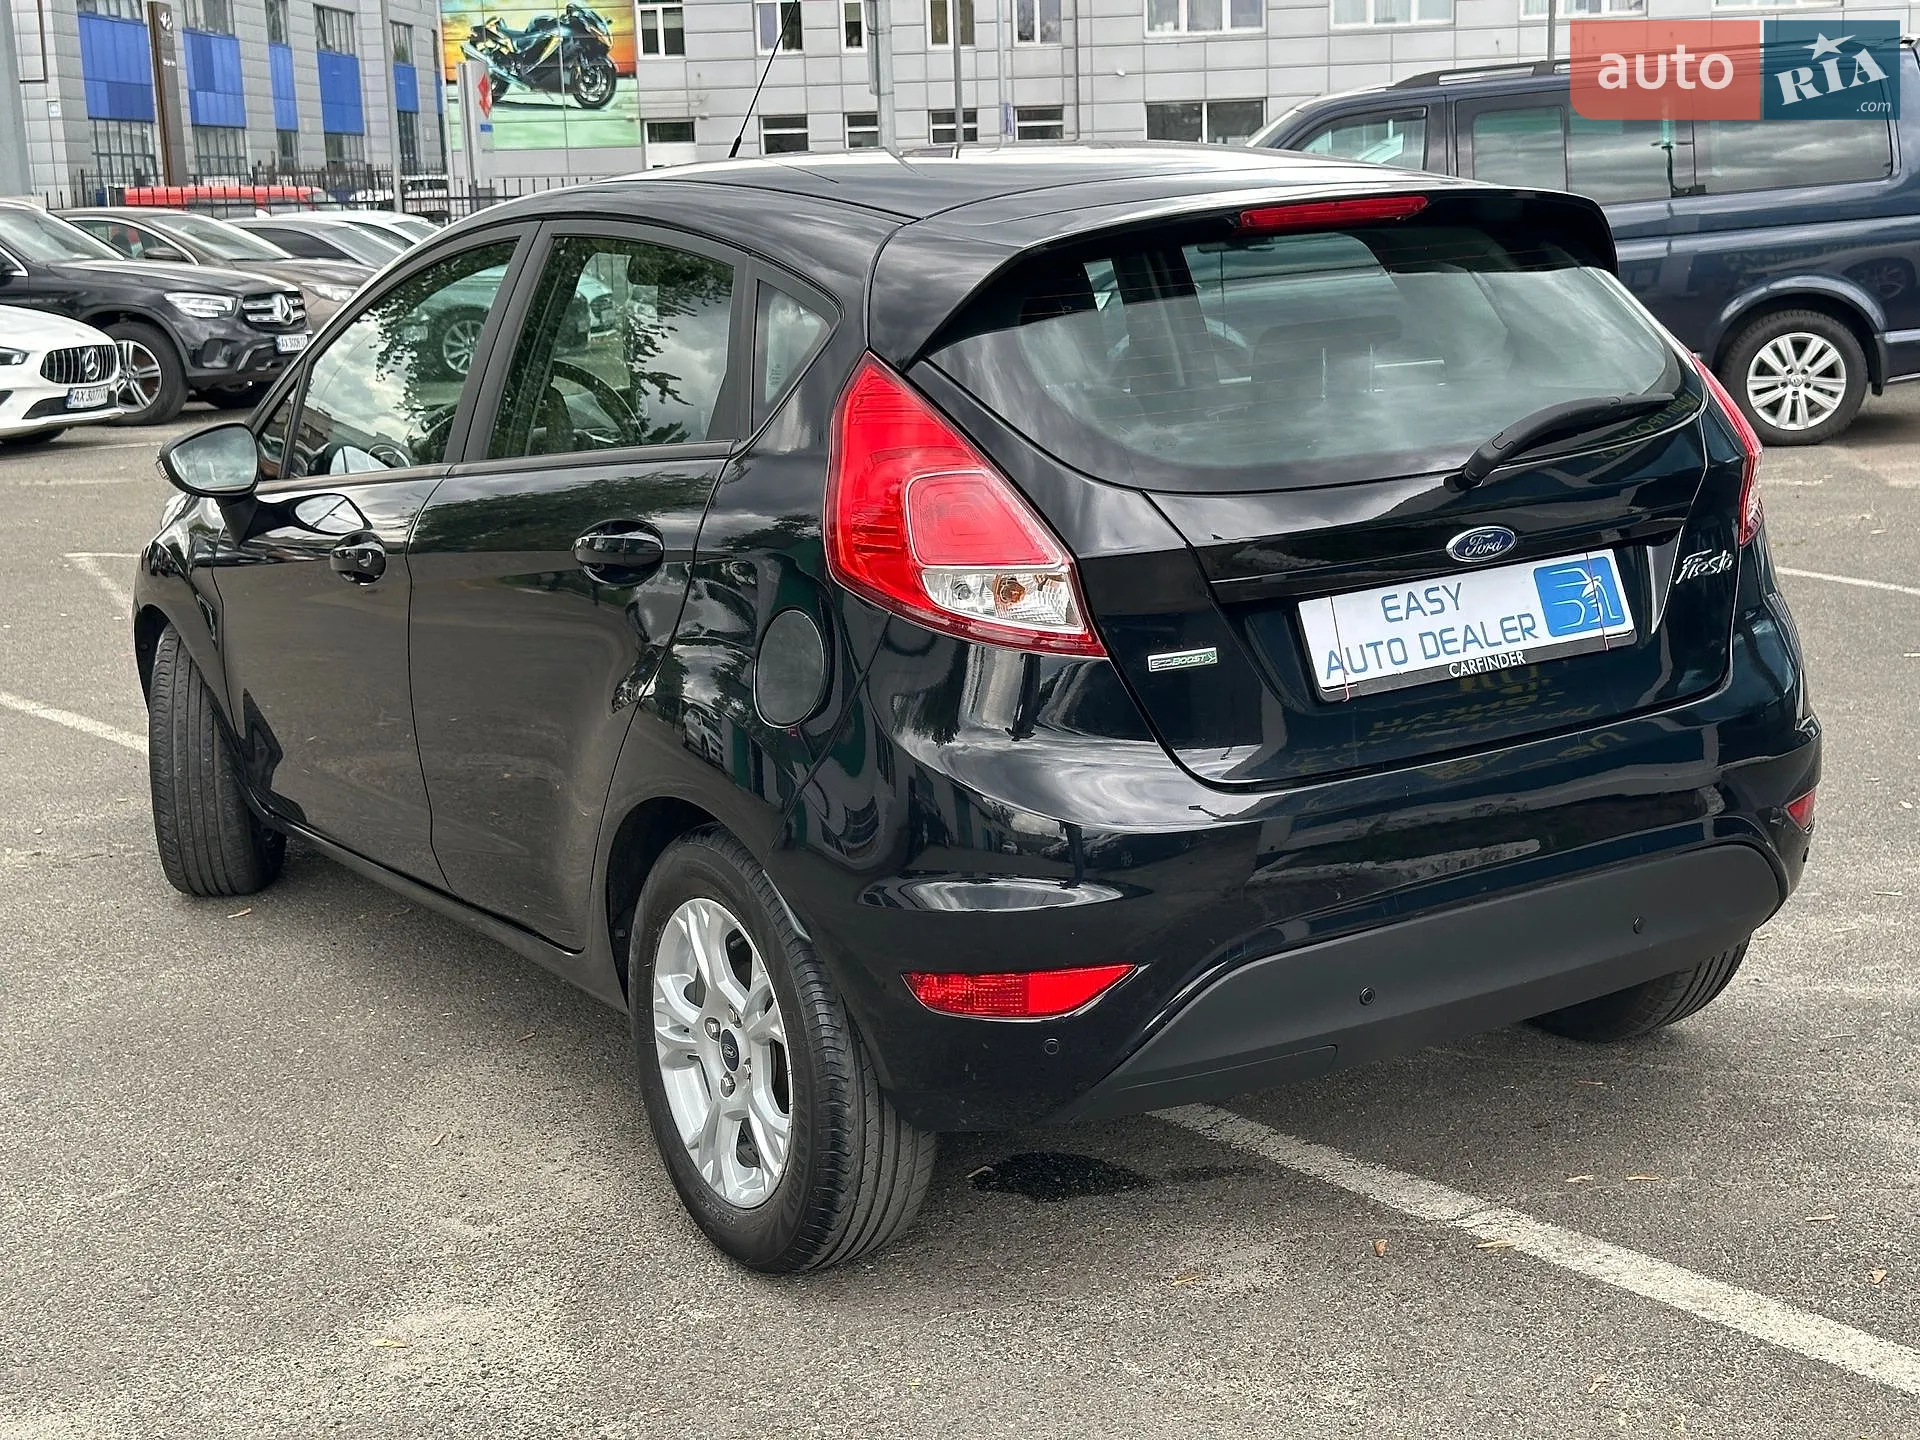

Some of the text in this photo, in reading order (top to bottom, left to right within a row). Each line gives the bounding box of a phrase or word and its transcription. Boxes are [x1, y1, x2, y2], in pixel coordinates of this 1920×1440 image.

[1464, 533, 1504, 557] Ford
[1675, 549, 1734, 585] Fiesta
[1381, 582, 1462, 623] EASY
[1326, 612, 1540, 679] AUTO DEALER
[1448, 650, 1527, 678] CARFINDER
